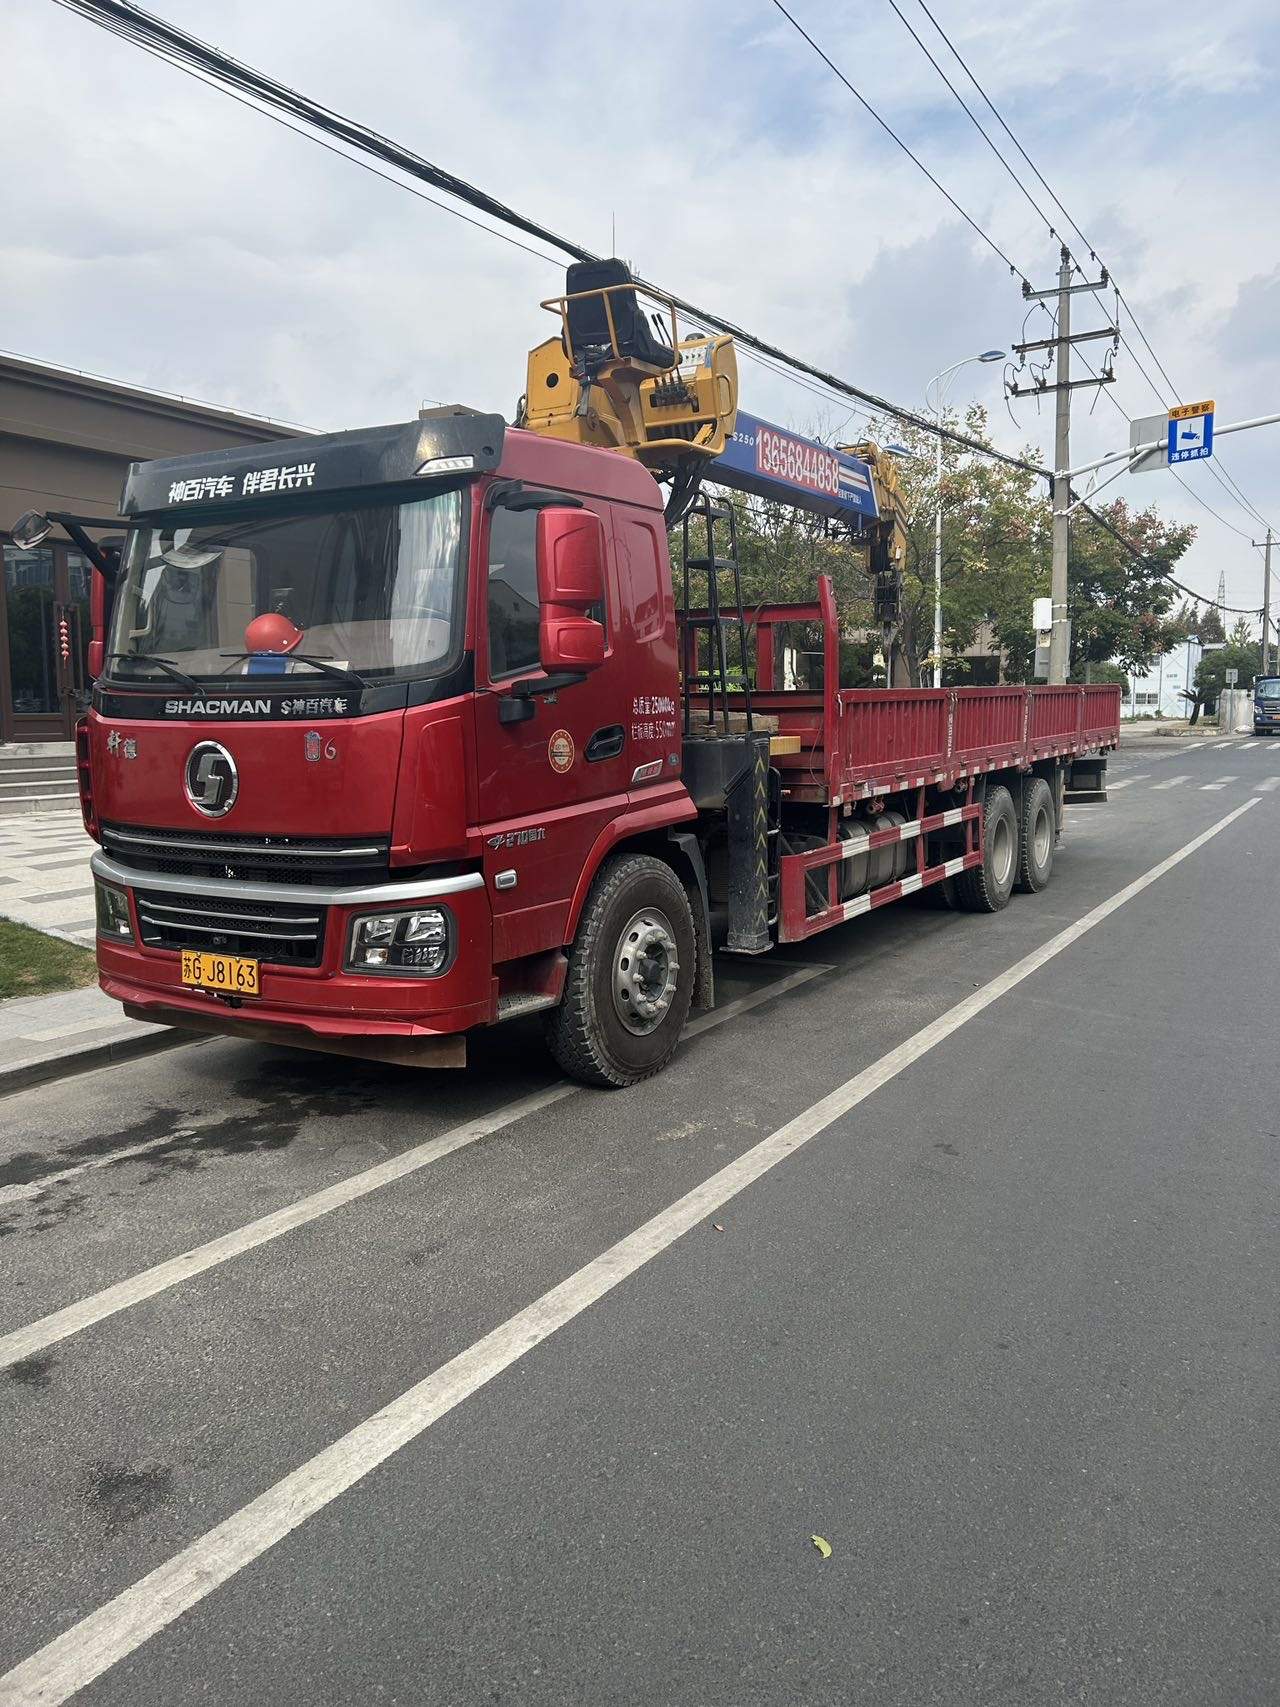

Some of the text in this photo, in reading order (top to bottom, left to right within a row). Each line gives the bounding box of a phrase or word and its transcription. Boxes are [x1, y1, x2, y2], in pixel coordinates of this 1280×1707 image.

[1171, 403, 1210, 418] 电子警察
[729, 431, 754, 446] S250
[755, 429, 839, 494] 13656844858
[1171, 447, 1209, 461] 违停抓拍
[168, 462, 316, 504] 神百汽车 伴君长兴
[165, 699, 271, 715] SHACMAN
[292, 697, 348, 715] 神百汽车
